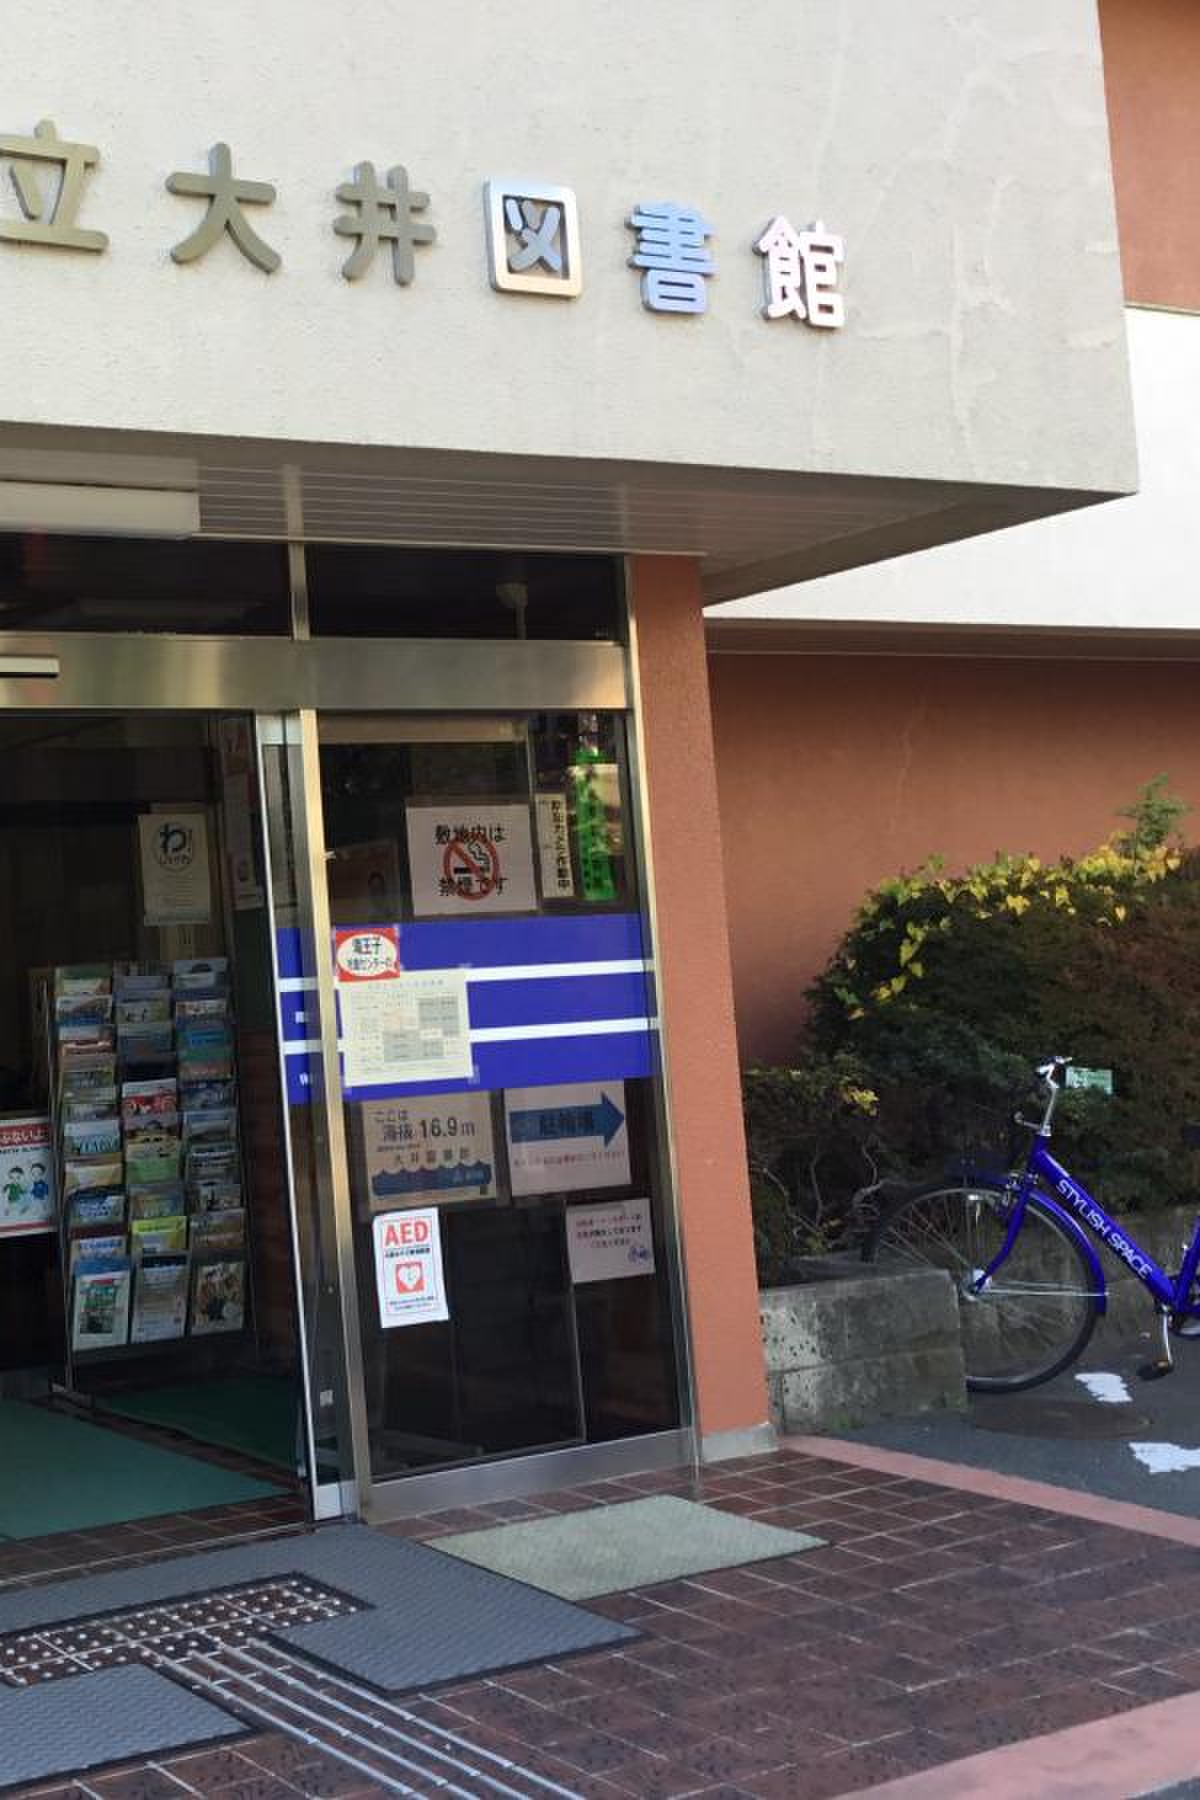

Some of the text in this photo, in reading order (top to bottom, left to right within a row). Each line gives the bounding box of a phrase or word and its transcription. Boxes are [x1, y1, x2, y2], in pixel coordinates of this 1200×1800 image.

[435, 823, 506, 845] 敷地内は
[438, 876, 508, 896] 禁煙です
[385, 1220, 429, 1247] AED
[1056, 1178, 1153, 1279] STYLISH SPACE
